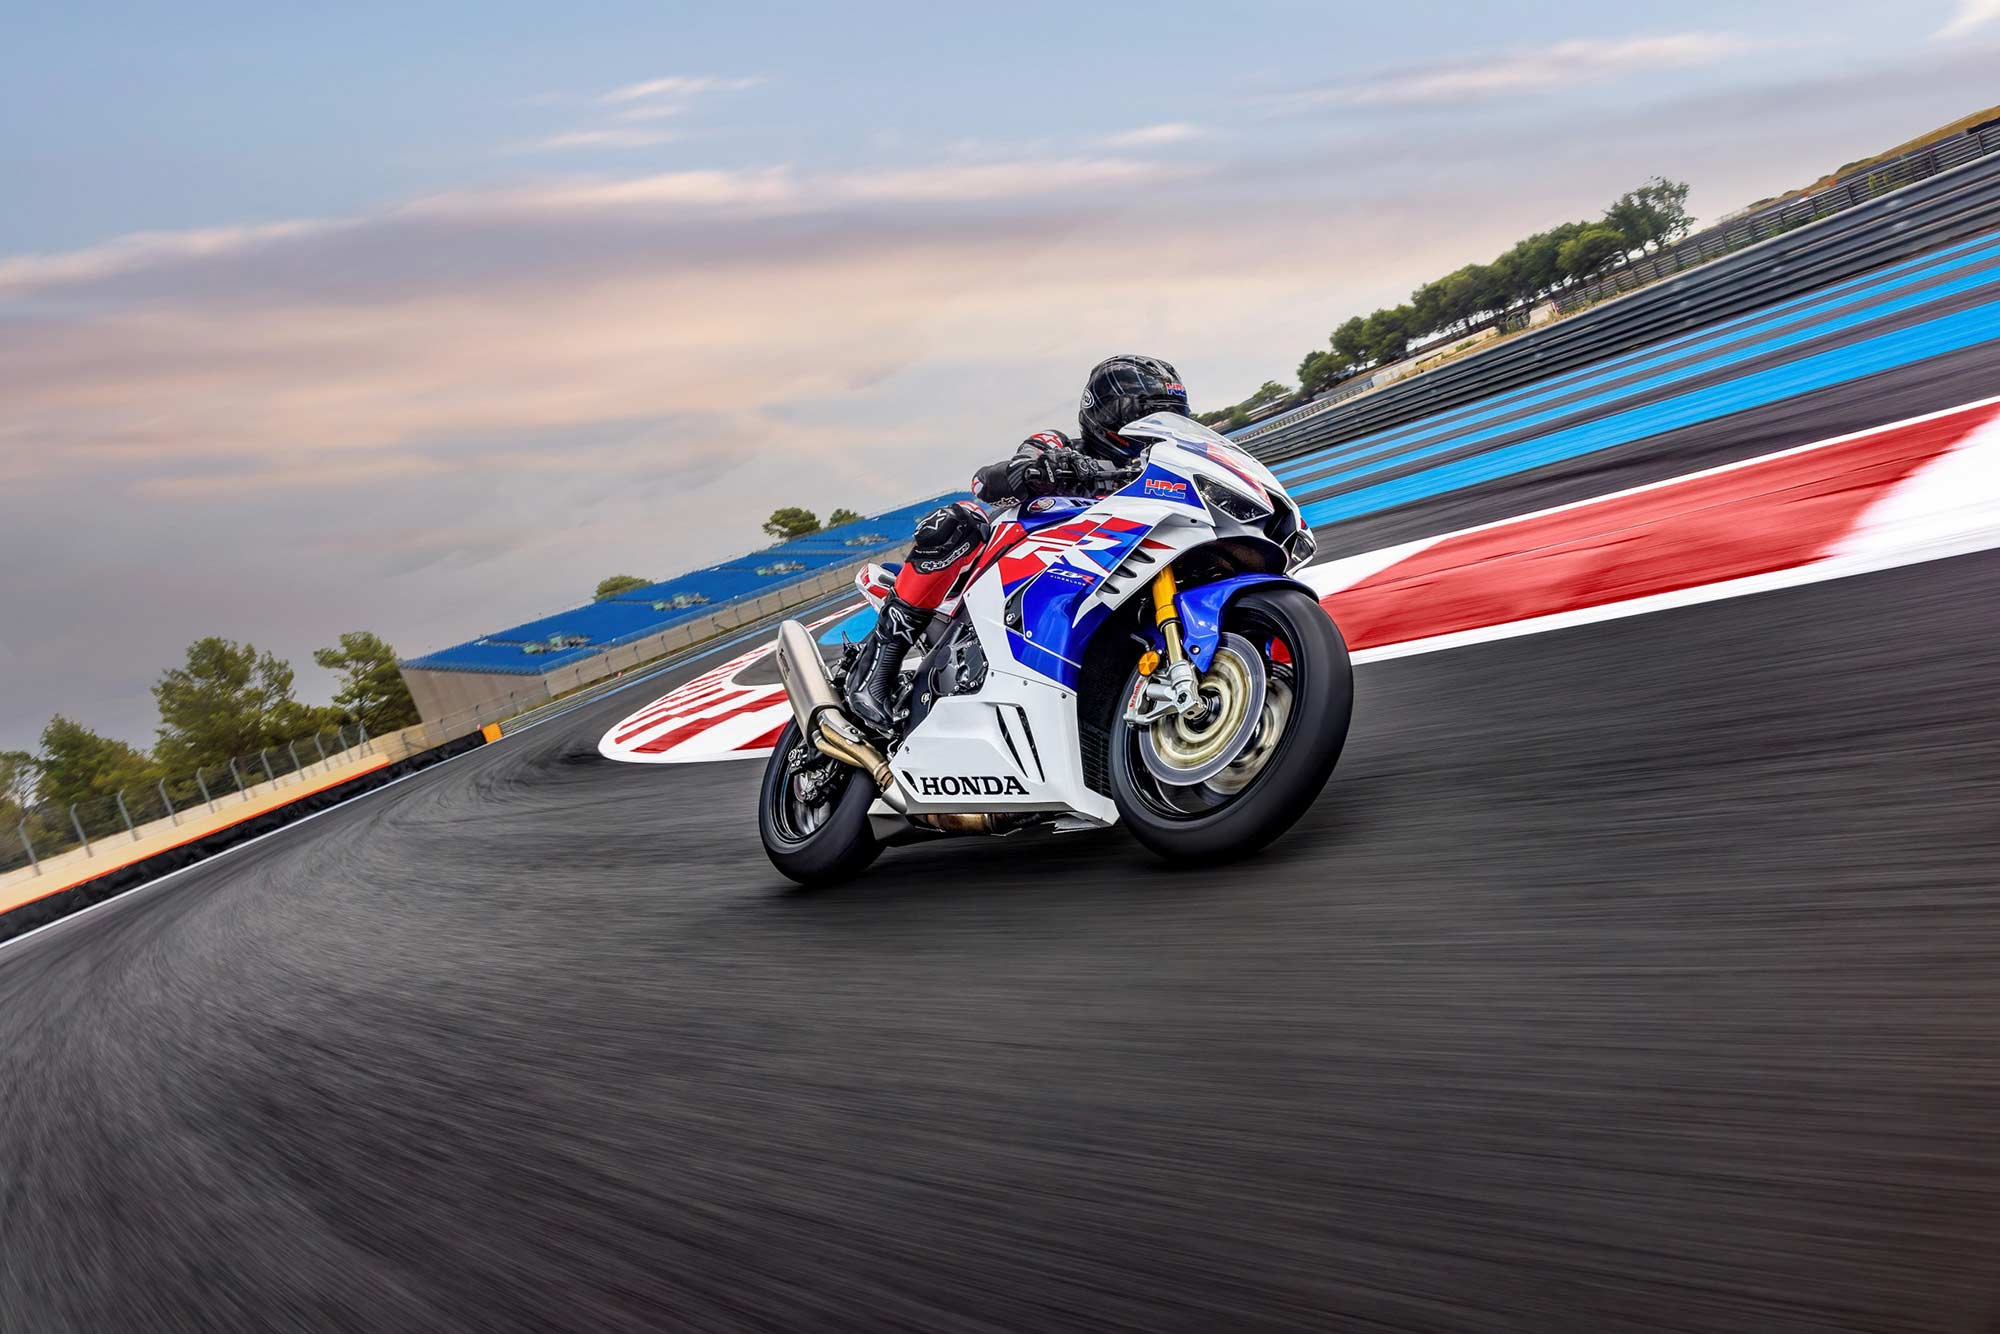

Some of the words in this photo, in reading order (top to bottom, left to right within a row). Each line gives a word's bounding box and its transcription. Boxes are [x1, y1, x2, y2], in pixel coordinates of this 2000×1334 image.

[1144, 478, 1187, 500] HRC
[1046, 568, 1097, 587] CBR
[919, 775, 1031, 796] HONDA
